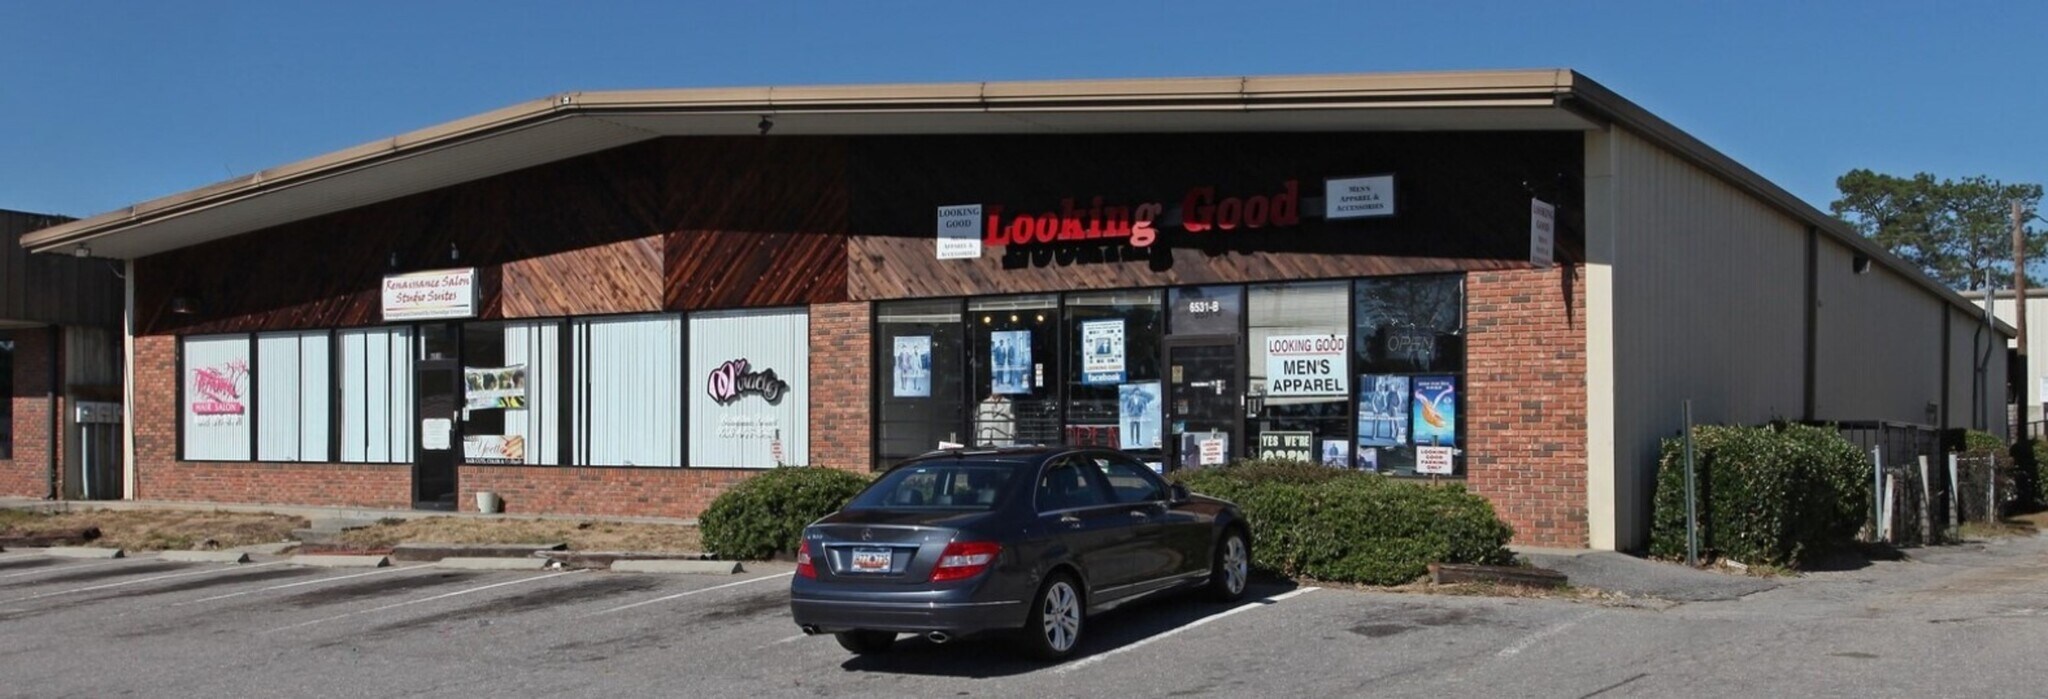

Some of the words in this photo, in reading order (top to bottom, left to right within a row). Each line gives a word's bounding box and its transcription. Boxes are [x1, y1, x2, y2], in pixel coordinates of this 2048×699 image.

[1340, 194, 1372, 202] APPAREL
[939, 207, 980, 217] LOOKING
[1336, 203, 1385, 211] ACCESSORIES
[984, 196, 1163, 248] Looking
[1181, 180, 1299, 233] Good
[946, 219, 972, 228] GOOD
[385, 279, 440, 292] Renaissance
[441, 275, 470, 287] Salon
[396, 291, 426, 304] Studio
[427, 289, 457, 302] Suites
[1189, 301, 1219, 313] 6531-B
[1269, 339, 1312, 353] LOOKING
[1315, 338, 1345, 351] GOOD
[1387, 335, 1434, 352] OPEN
[1283, 359, 1330, 375] MEN'S
[1273, 379, 1344, 392] APPAREL
[214, 402, 238, 411] SALON
[1261, 435, 1278, 447] YES
[1284, 435, 1310, 447] WE'RE
